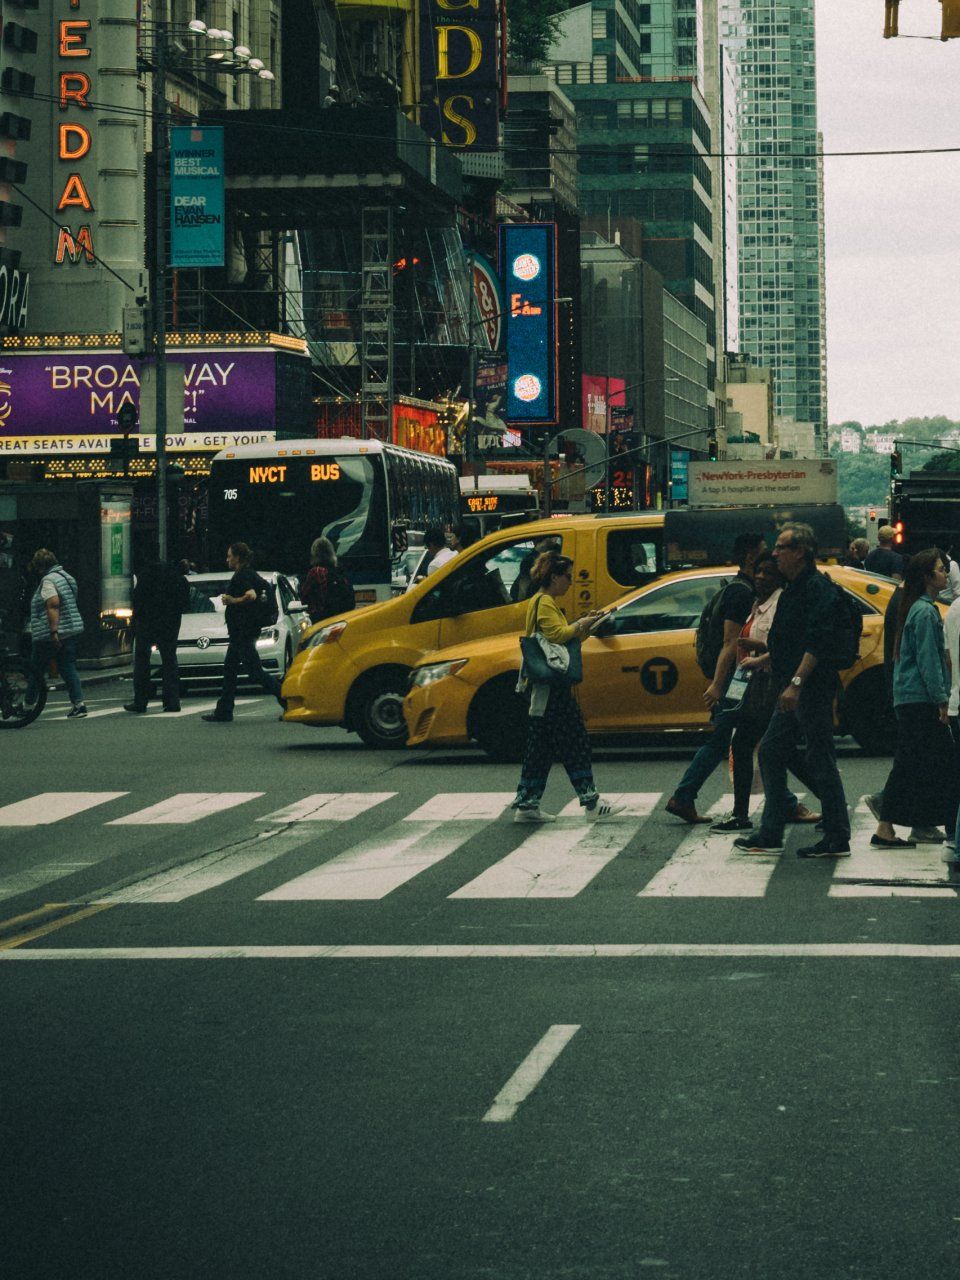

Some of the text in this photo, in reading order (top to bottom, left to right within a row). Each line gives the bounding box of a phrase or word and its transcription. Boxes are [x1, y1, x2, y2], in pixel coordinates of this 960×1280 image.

[174, 149, 216, 158] WINNER
[174, 158, 202, 167] BEST
[174, 166, 220, 176] MUSICAL
[174, 196, 207, 206] DEAR
[174, 206, 205, 215] EVAN
[174, 214, 221, 225] HANSEN
[34, 439, 74, 449] SEATS
[78, 437, 151, 449] AVAILE
[203, 436, 229, 446] GET
[248, 463, 341, 483] NYCT BUS
[702, 469, 807, 482] NewYork-Presbyterian
[223, 488, 239, 501] 705
[708, 486, 721, 495] top
[727, 485, 755, 494] hospital
[649, 664, 670, 690] T
